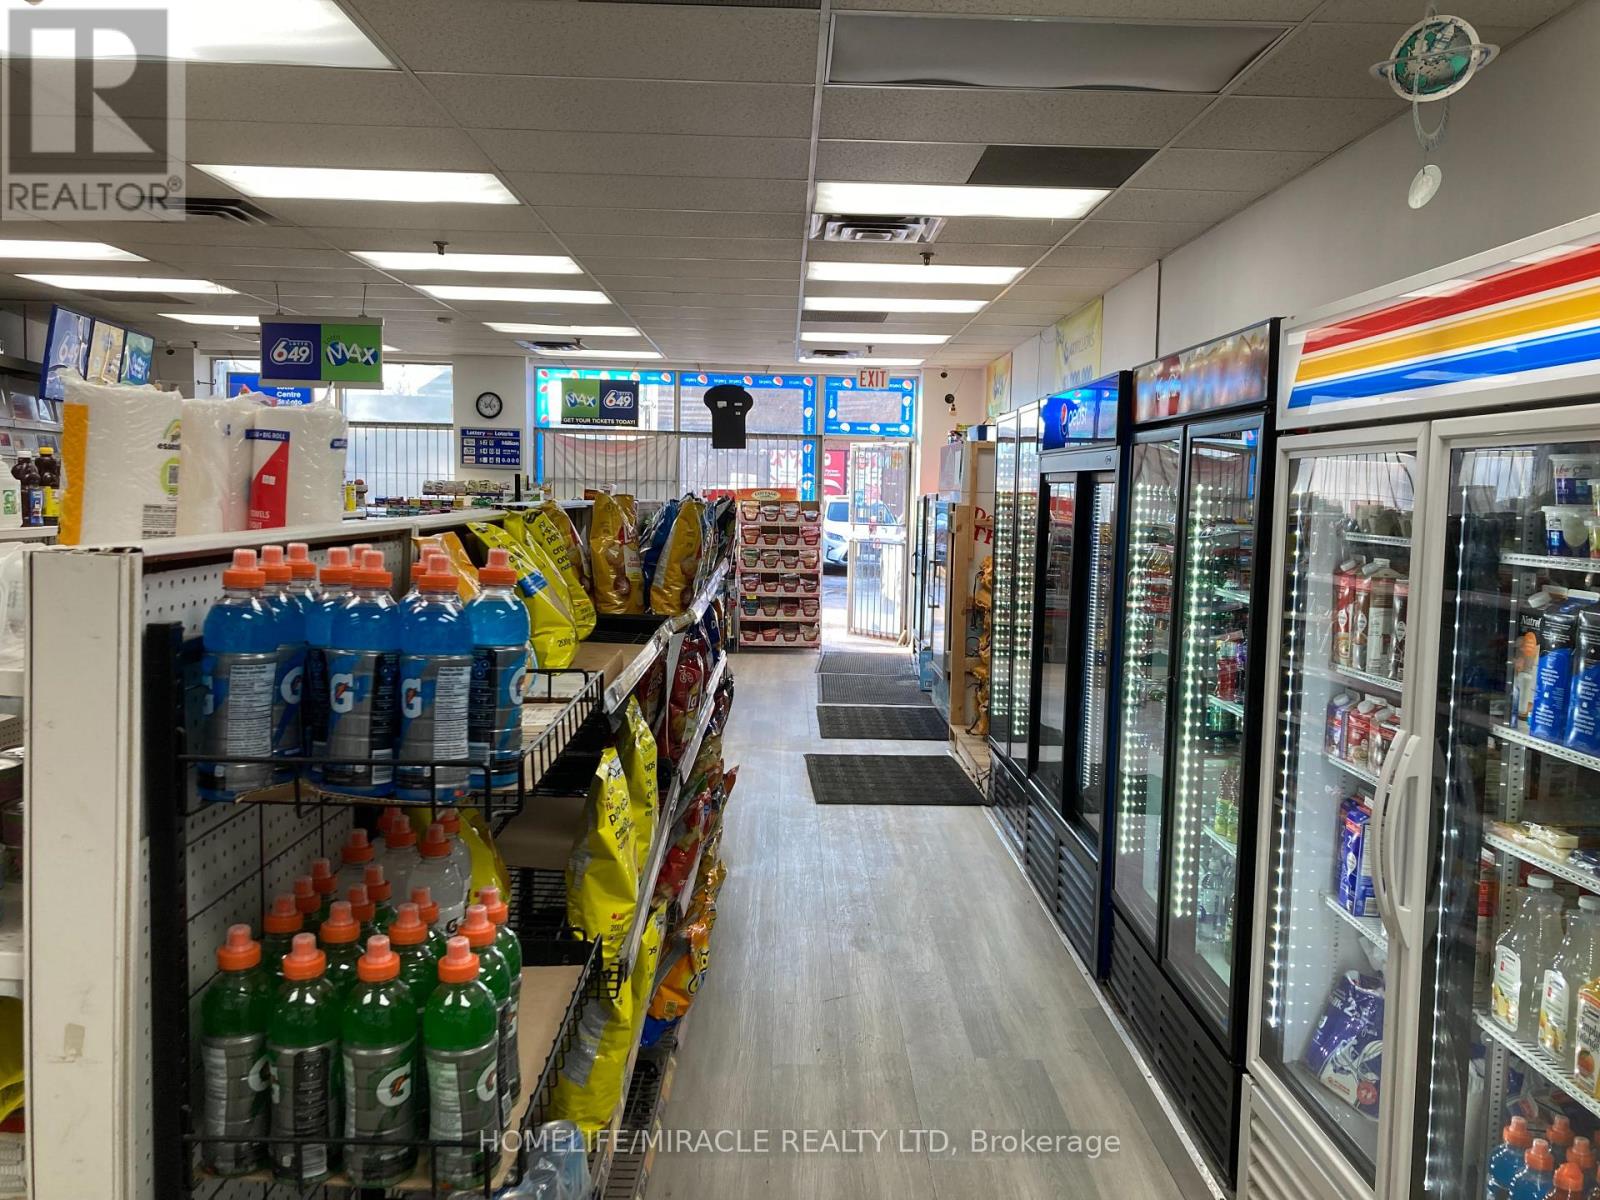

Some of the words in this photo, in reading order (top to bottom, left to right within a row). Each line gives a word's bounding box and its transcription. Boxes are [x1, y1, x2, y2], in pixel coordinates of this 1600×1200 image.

[273, 341, 311, 362] 649
[327, 341, 376, 366] MAX
[860, 370, 887, 387] EXIT
[605, 390, 632, 407] 649
[1521, 614, 1542, 627] Natrel
[330, 673, 354, 713] G
[402, 678, 422, 718] G
[376, 1064, 411, 1107] G
